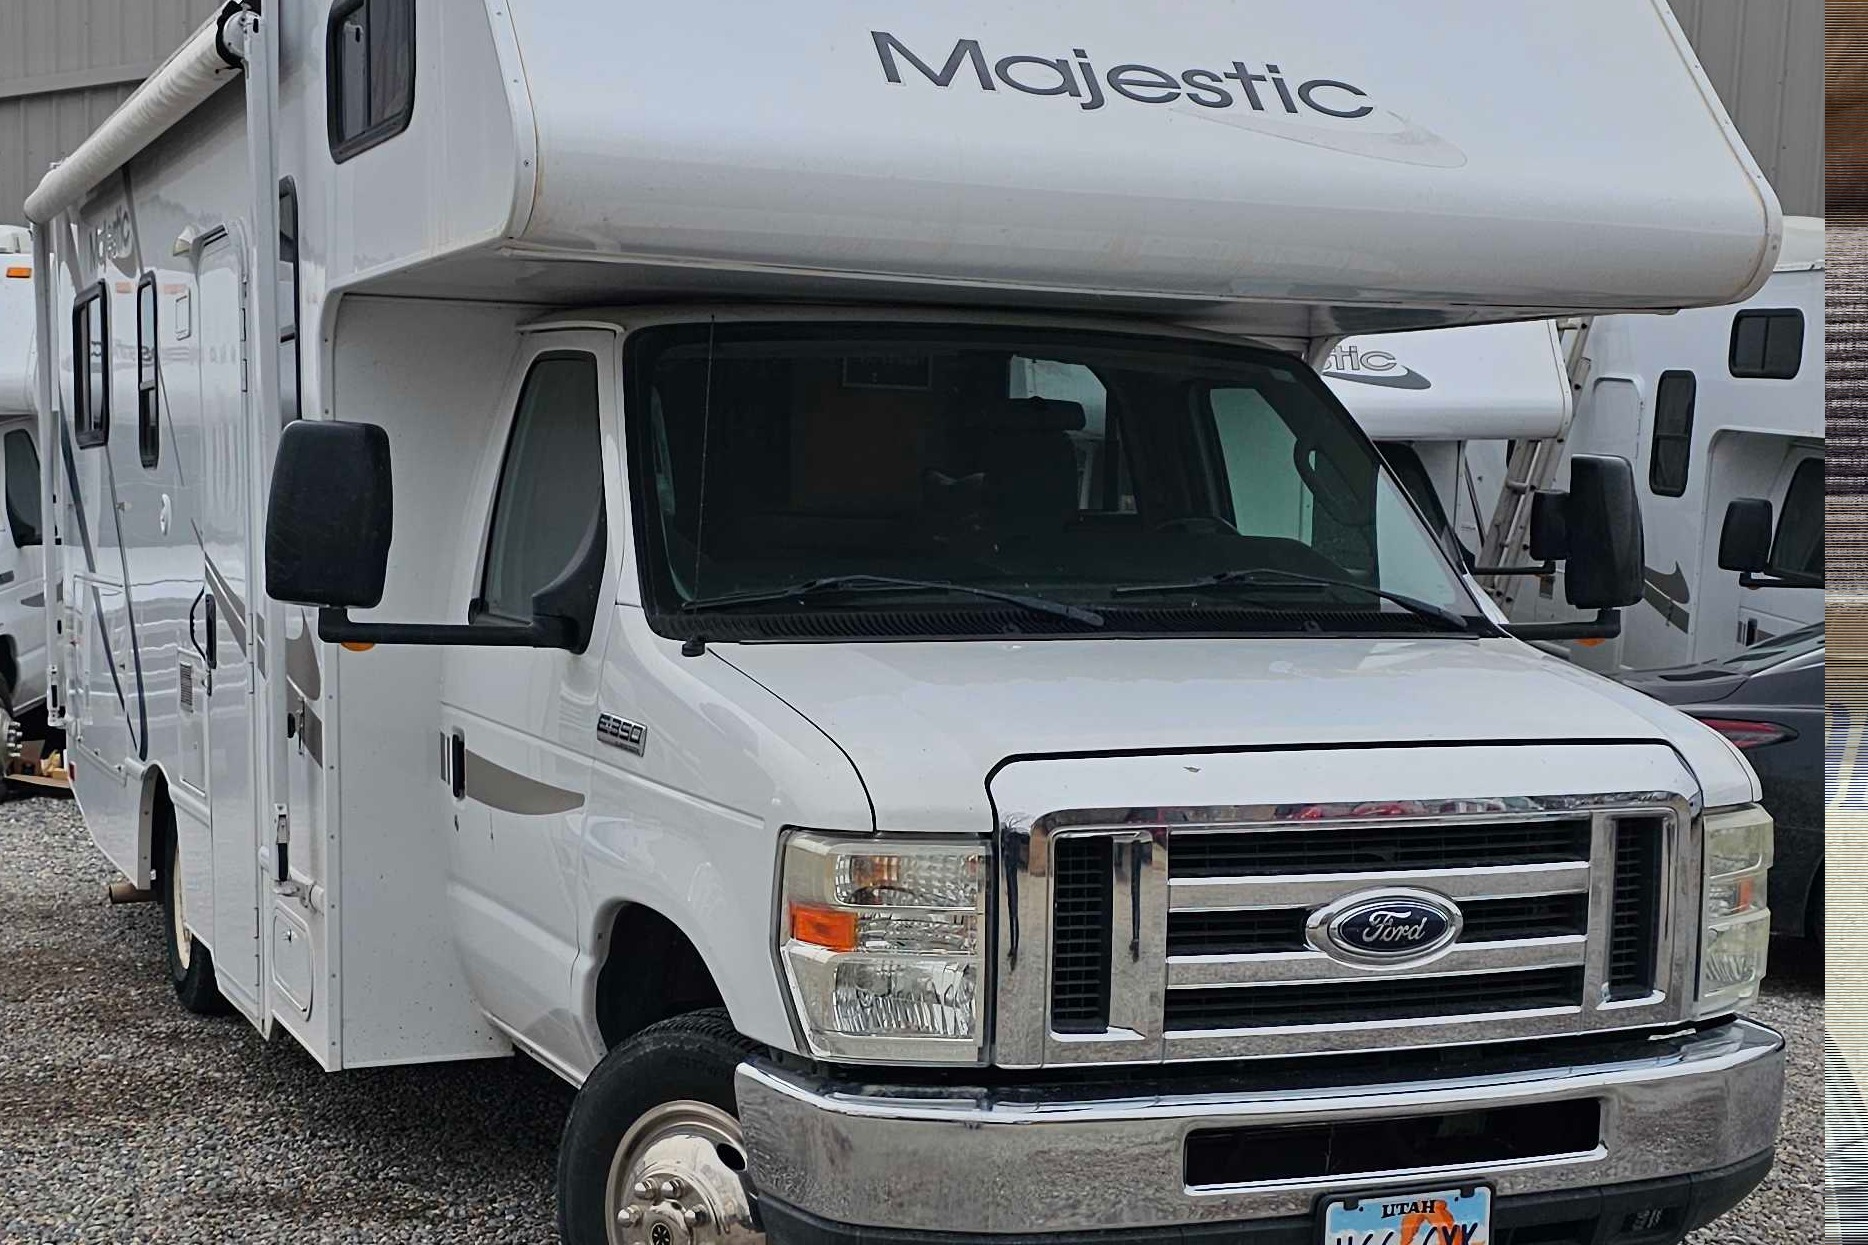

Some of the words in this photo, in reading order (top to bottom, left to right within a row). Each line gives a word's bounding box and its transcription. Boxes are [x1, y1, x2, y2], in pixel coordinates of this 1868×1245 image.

[870, 30, 1374, 118] Majestic
[1362, 910, 1428, 943] Ford
[1381, 1200, 1436, 1219] UTAH
